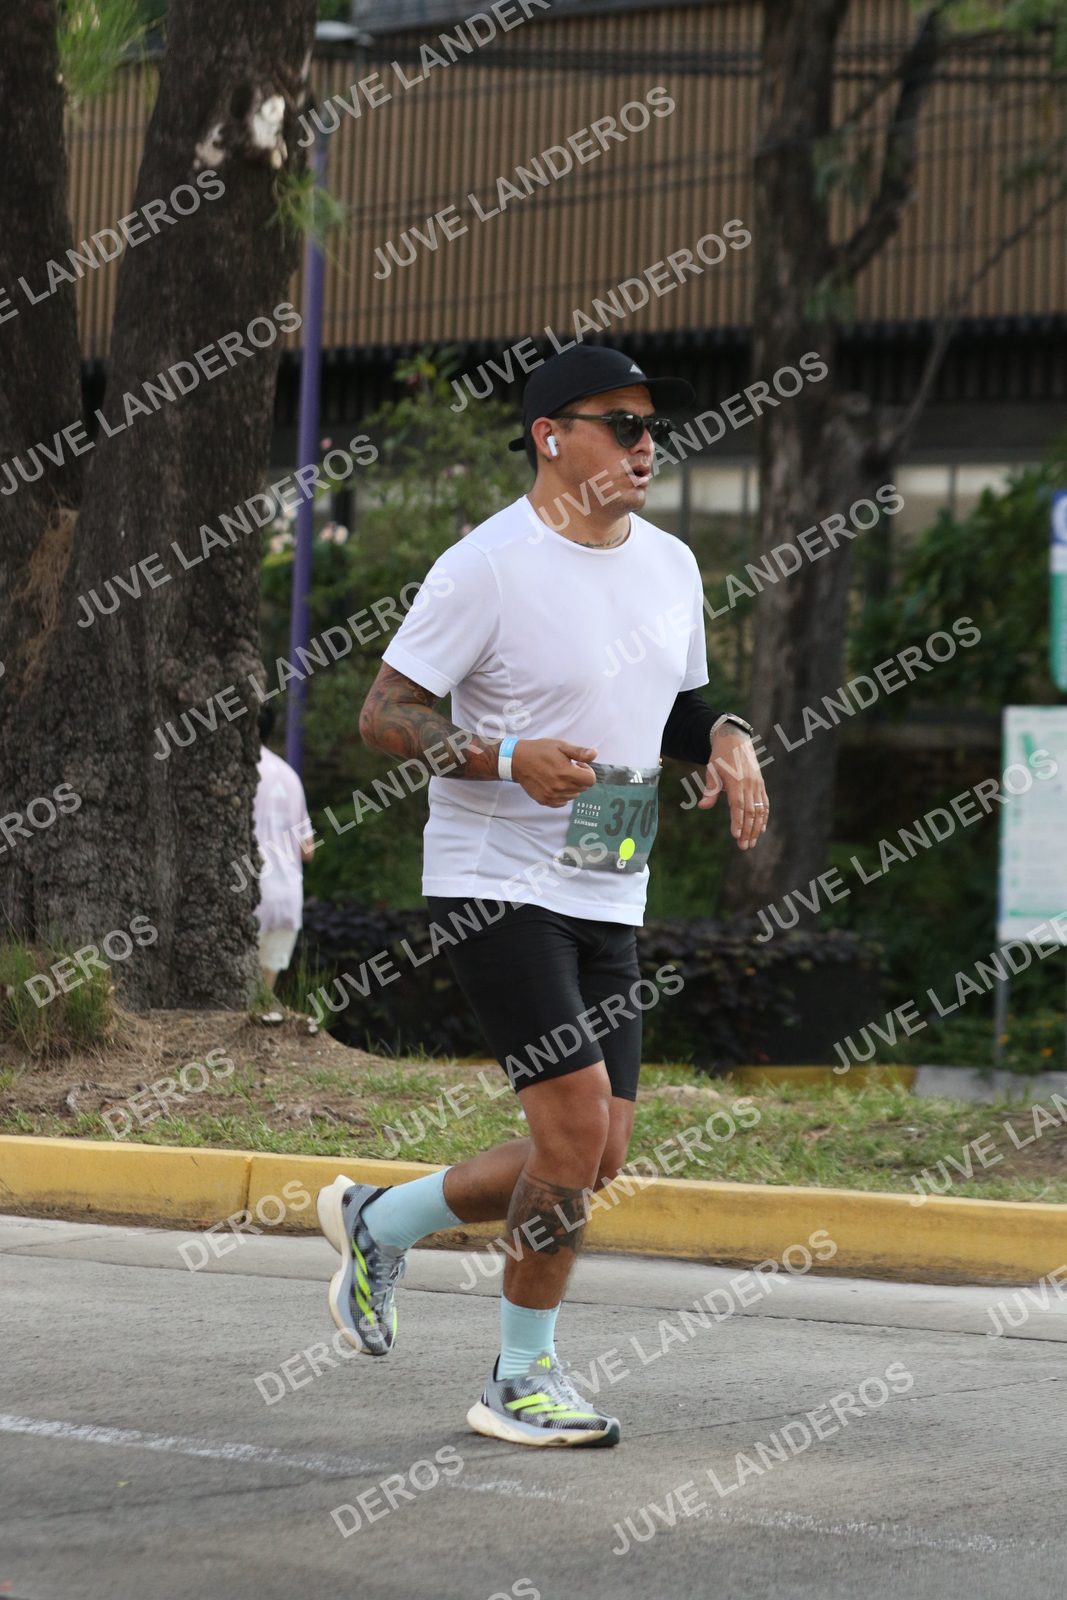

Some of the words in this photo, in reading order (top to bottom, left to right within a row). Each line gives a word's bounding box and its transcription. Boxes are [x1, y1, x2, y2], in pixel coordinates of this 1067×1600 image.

[577, 801, 602, 811] ADIDAS
[576, 809, 600, 817] SPLITS
[604, 797, 658, 839] 370
